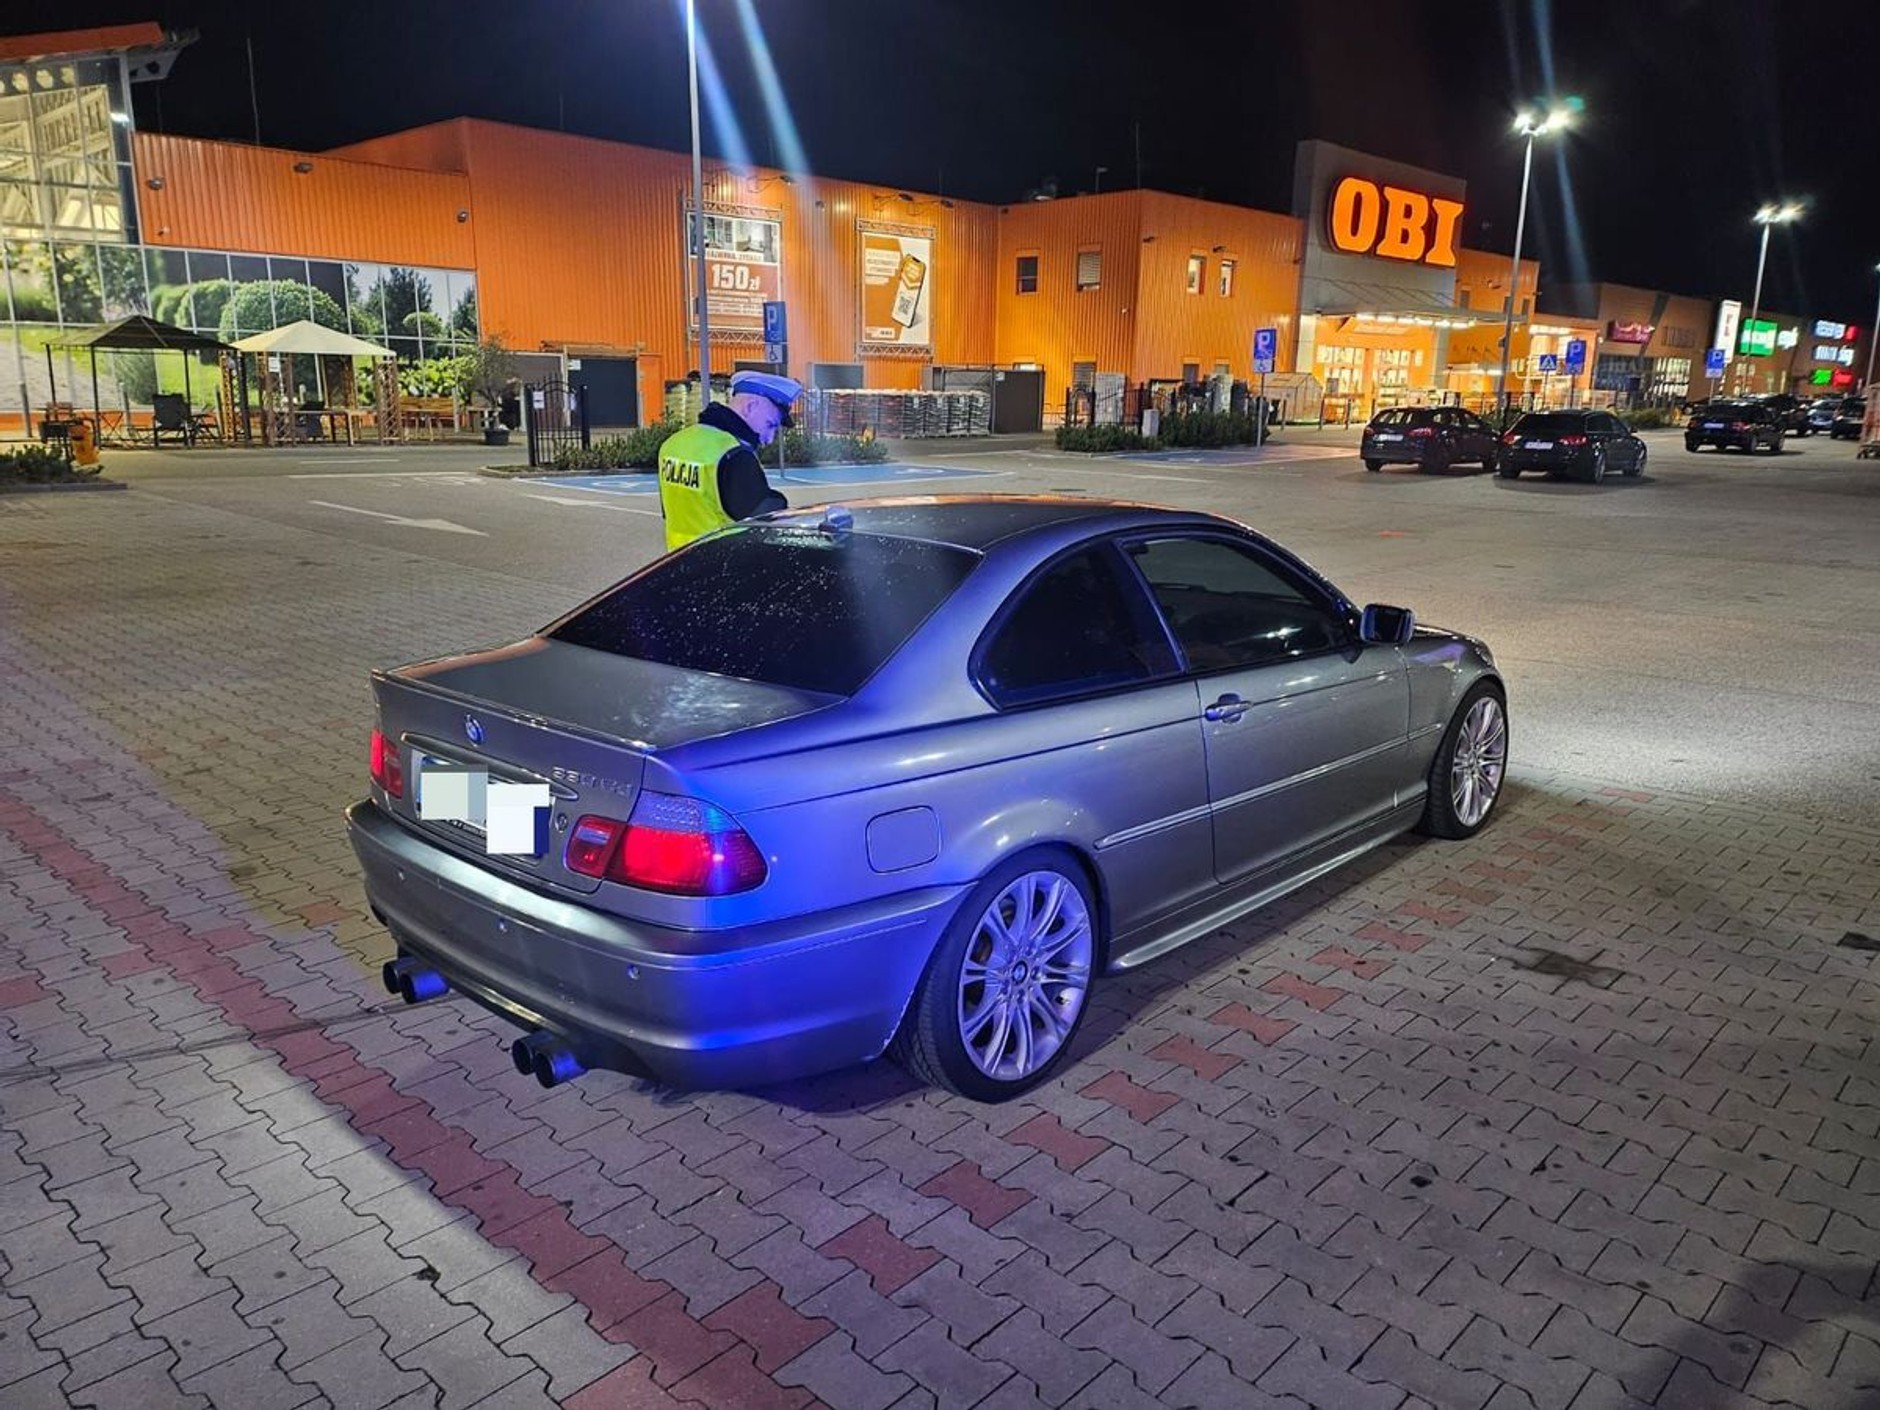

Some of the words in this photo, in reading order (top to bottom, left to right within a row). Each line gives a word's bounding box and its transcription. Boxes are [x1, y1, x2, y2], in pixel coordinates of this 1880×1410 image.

[1332, 177, 1464, 267] OBI
[711, 263, 749, 289] 150
[767, 306, 777, 330] P
[1258, 332, 1270, 351] P
[661, 458, 700, 488] POLICJA
